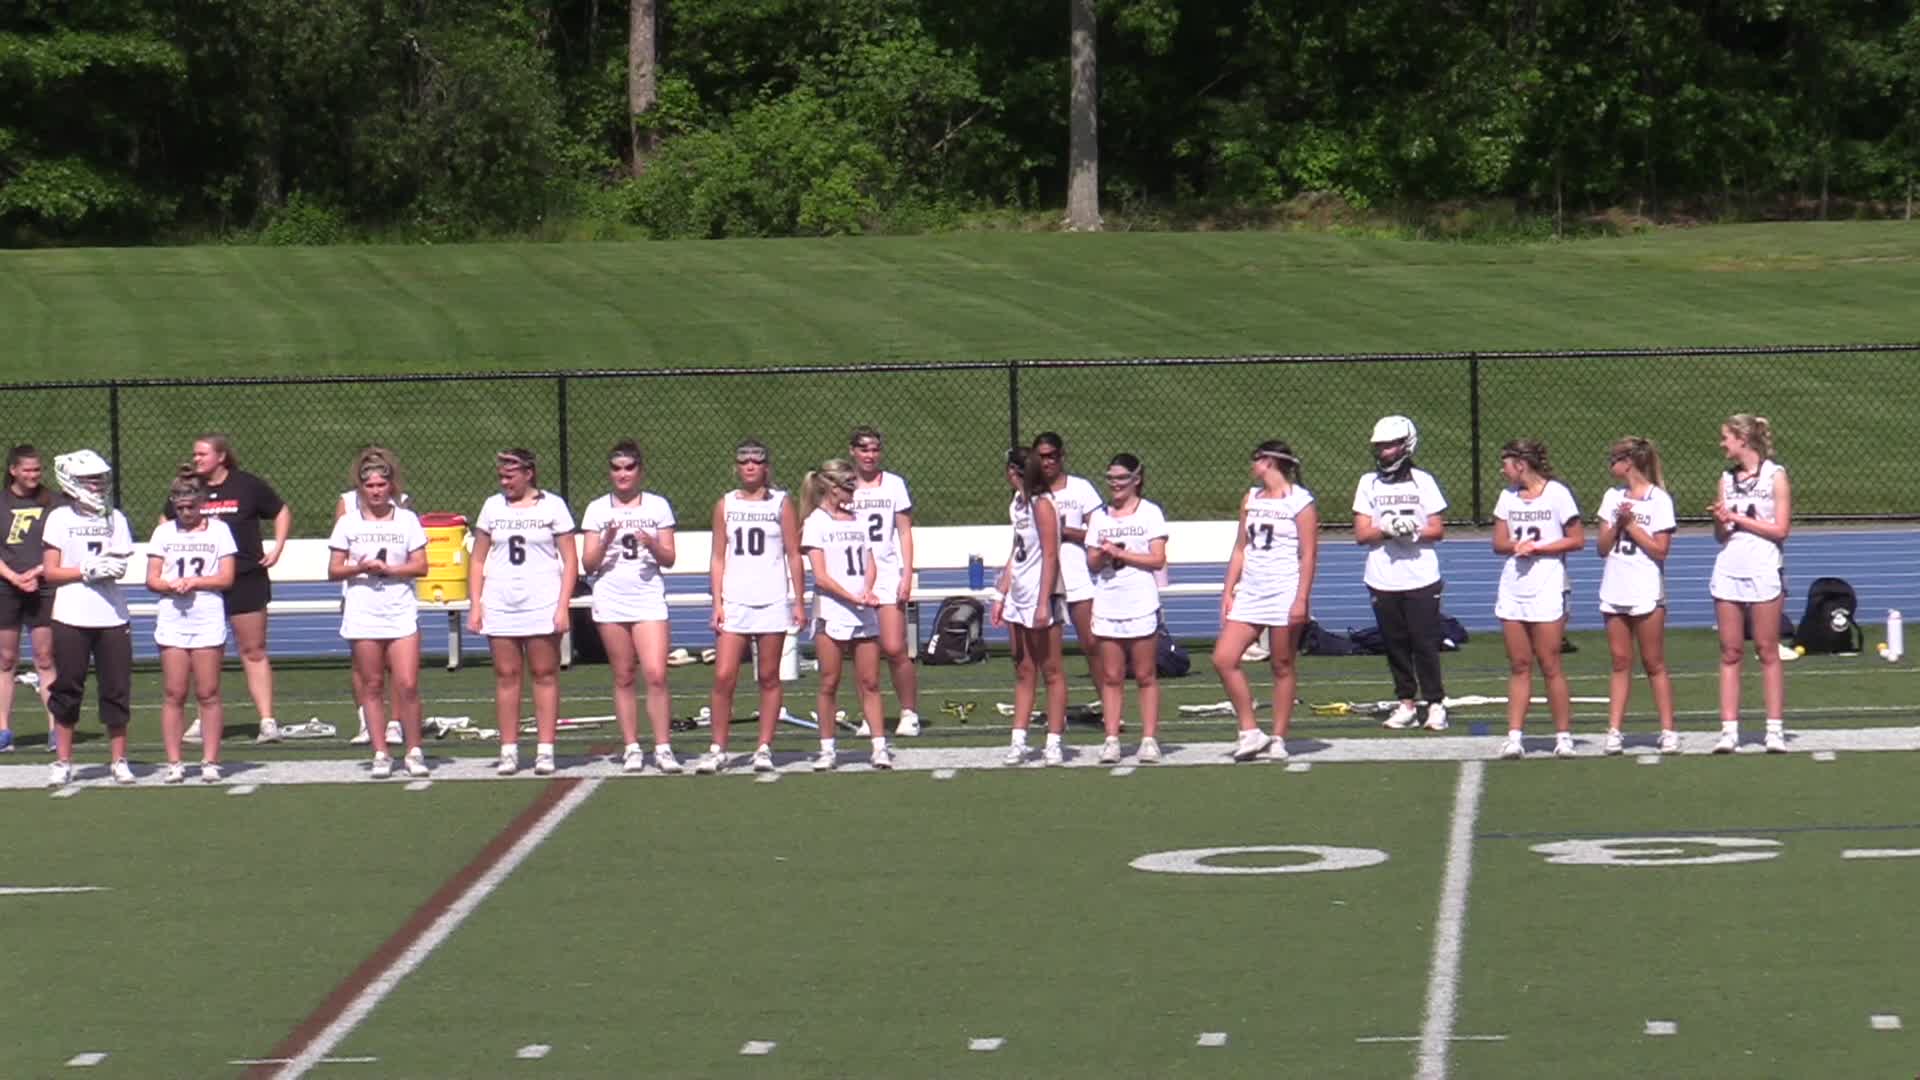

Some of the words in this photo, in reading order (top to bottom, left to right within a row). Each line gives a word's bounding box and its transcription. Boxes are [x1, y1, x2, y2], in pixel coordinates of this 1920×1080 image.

[726, 511, 777, 521] FOXBORO
[849, 499, 891, 510] OXBORO
[6, 507, 44, 544] F
[495, 519, 544, 530] FOXBORO
[868, 513, 884, 542] 2
[1248, 522, 1275, 551] 17
[508, 535, 526, 566] 6
[621, 533, 639, 560] 9
[733, 526, 766, 556] 10
[844, 545, 865, 576] 11
